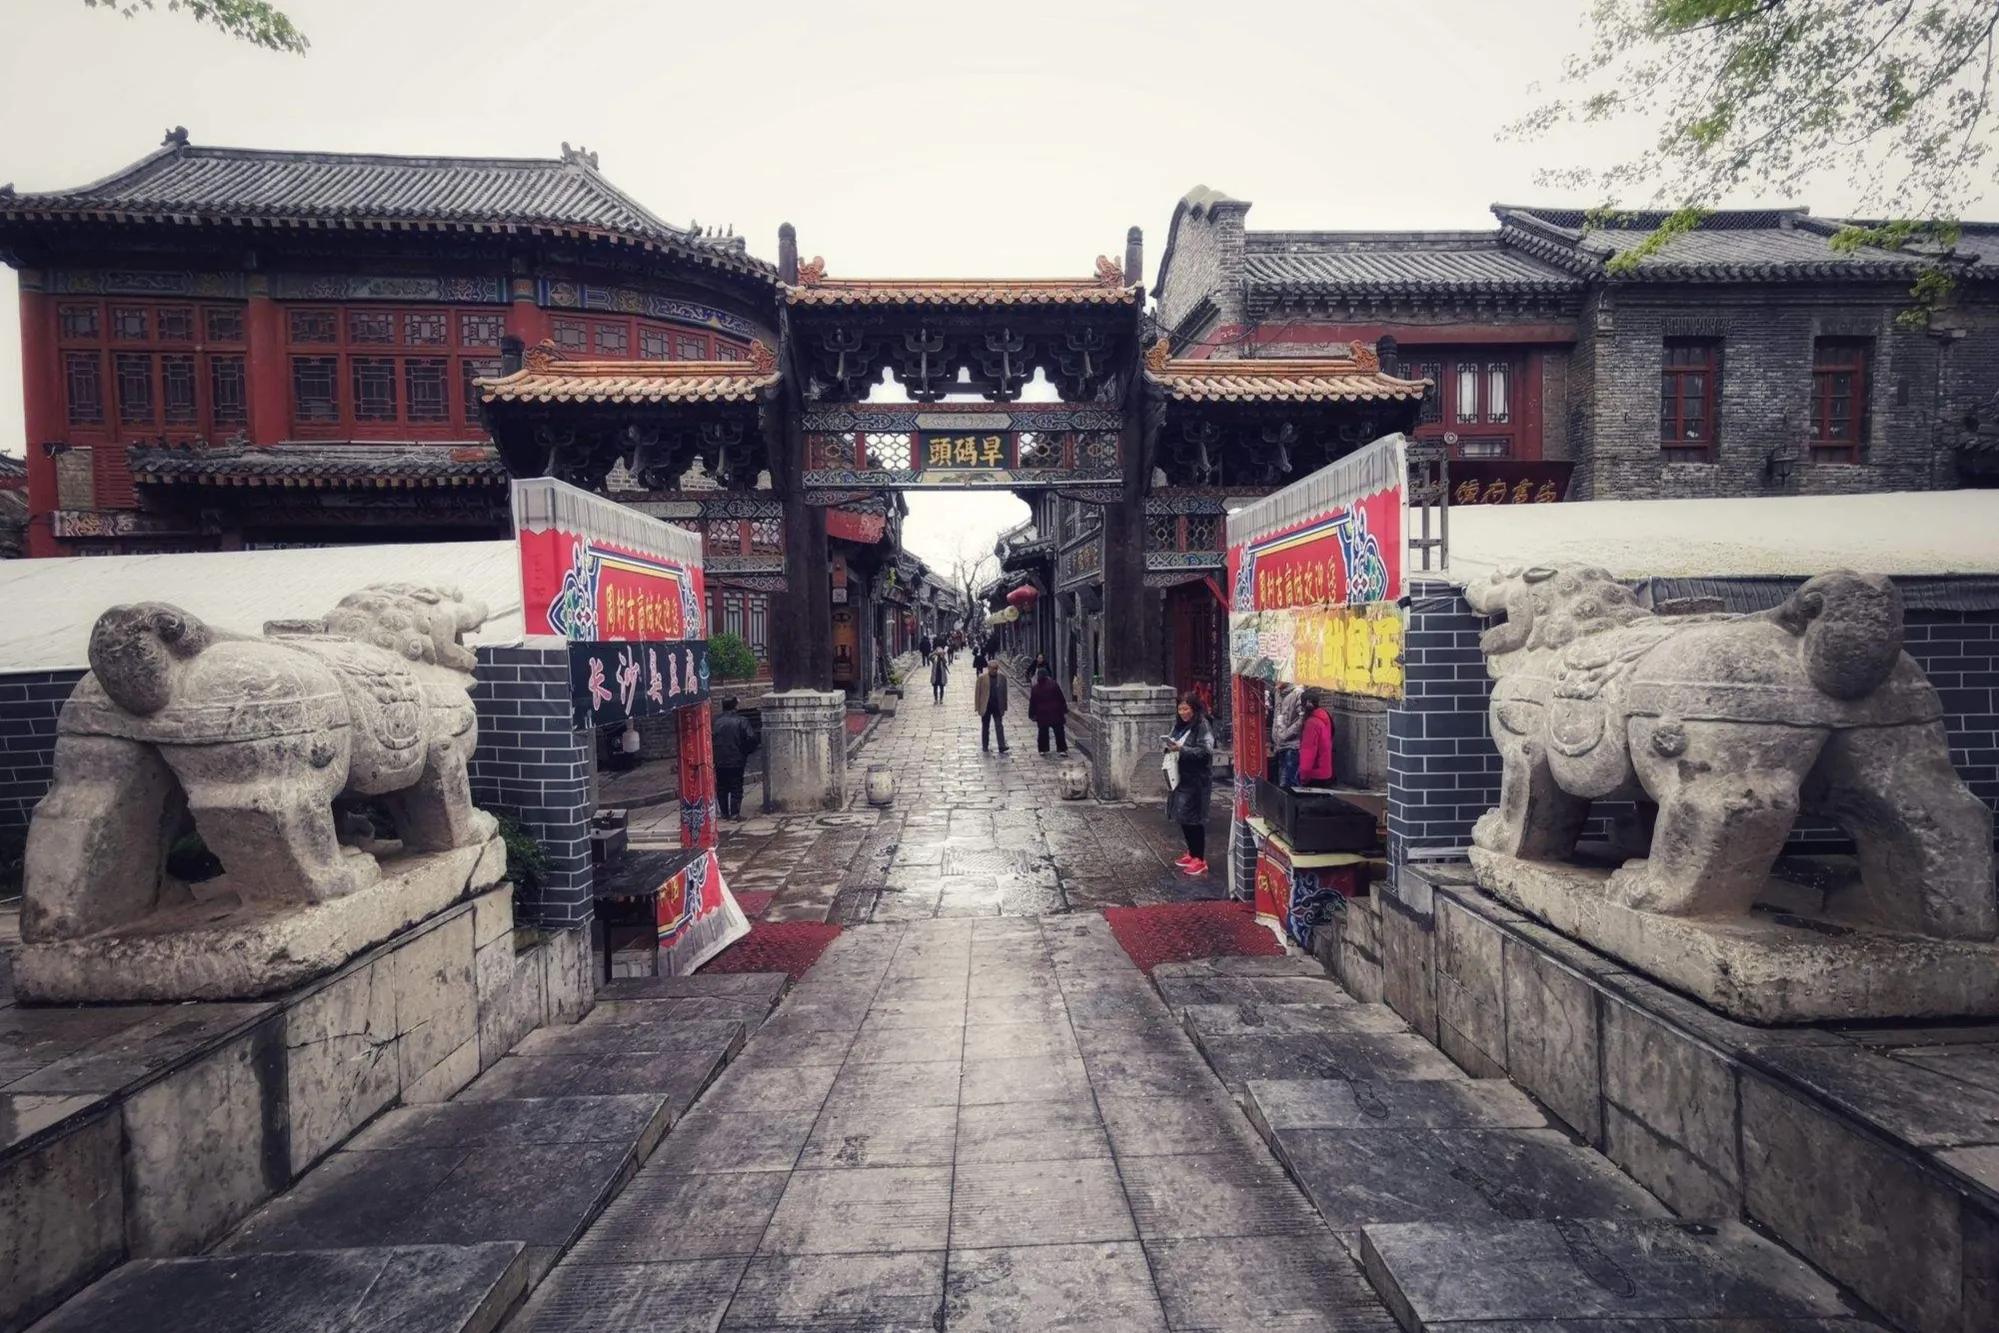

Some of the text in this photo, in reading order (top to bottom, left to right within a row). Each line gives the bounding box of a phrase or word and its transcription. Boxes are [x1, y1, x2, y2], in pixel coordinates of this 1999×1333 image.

[928, 435, 1004, 468] 旱碼頭
[588, 645, 699, 716] 长沙臭豆腐
